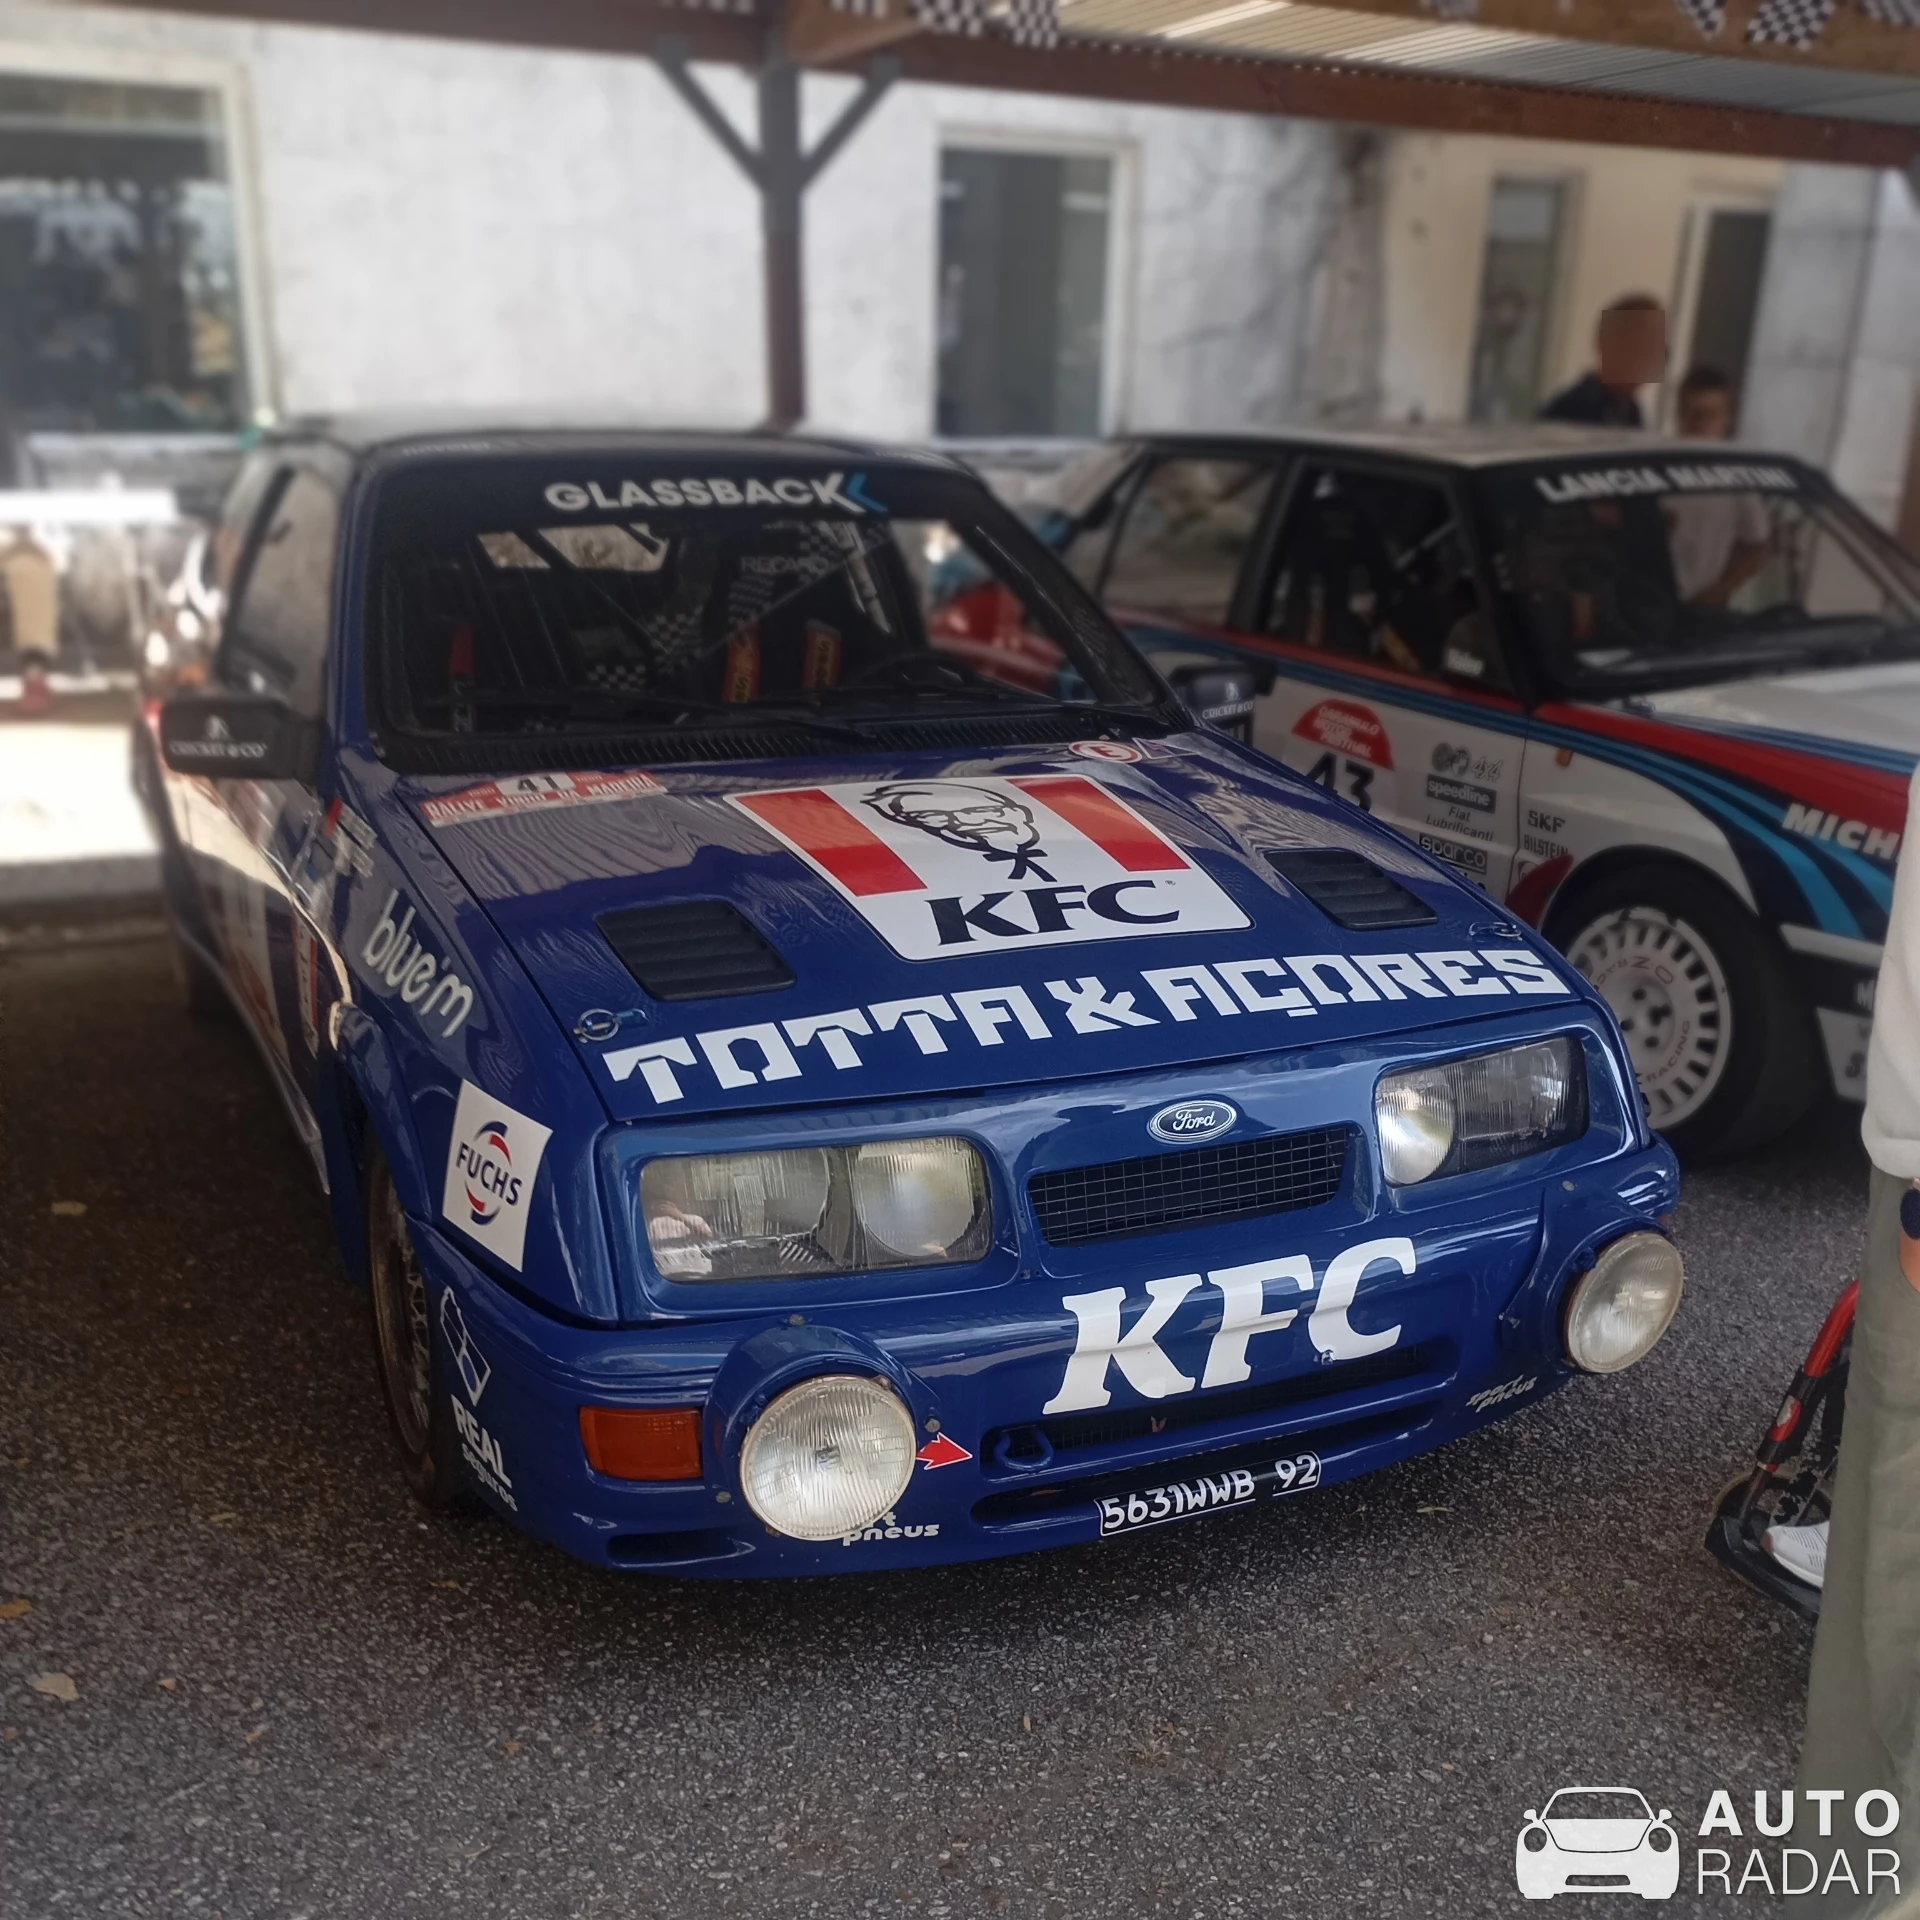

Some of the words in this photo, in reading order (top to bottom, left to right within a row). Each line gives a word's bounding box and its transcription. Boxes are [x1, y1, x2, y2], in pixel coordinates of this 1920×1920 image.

[544, 472, 866, 514] GLASSBACK
[1534, 467, 1670, 503] LANCIA
[1665, 464, 1798, 490] MARTINI
[1428, 780, 1491, 806] speedline
[1425, 814, 1494, 842] Lubrificanti
[1449, 806, 1471, 822] Fiat
[1527, 810, 1567, 834] SKF
[1782, 802, 1899, 862] MICH
[1420, 836, 1487, 868] sparco
[924, 879, 1180, 946] KFC
[602, 985, 1054, 1105] TOTTA
[1047, 976, 1161, 1035] &
[1140, 949, 1571, 1023] AÇORES
[1172, 1107, 1217, 1132] Ford
[456, 1140, 523, 1207] FUCHS
[1043, 1237, 1418, 1415] KFC
[450, 1393, 513, 1490] REAL
[1102, 1469, 1256, 1529] 5631WWB
[1274, 1454, 1319, 1490] 92
[842, 1523, 940, 1547] pneus
